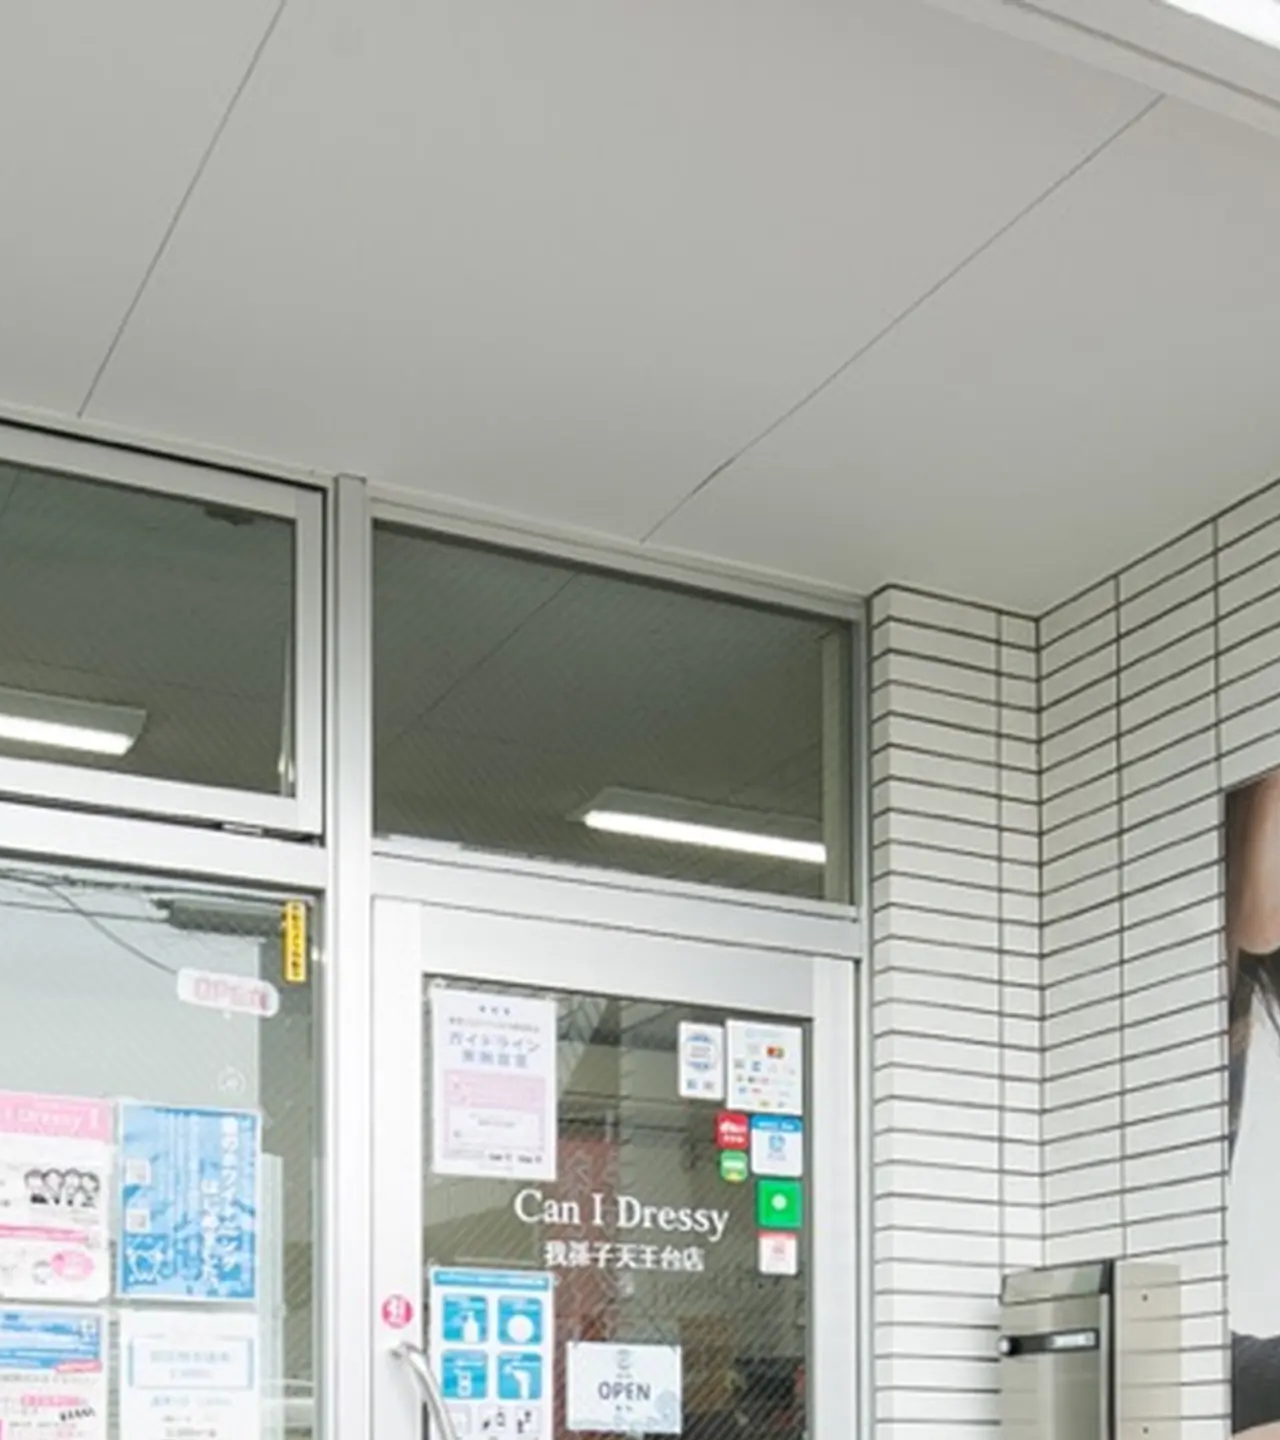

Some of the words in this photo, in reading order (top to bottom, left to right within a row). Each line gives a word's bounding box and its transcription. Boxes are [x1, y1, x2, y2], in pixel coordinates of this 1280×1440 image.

[512, 1188, 581, 1226] Can
[592, 1192, 605, 1226] I
[617, 1195, 730, 1243] Dressy
[543, 1240, 706, 1272] 我孫子天王台店
[598, 1380, 651, 1401] OPEN
